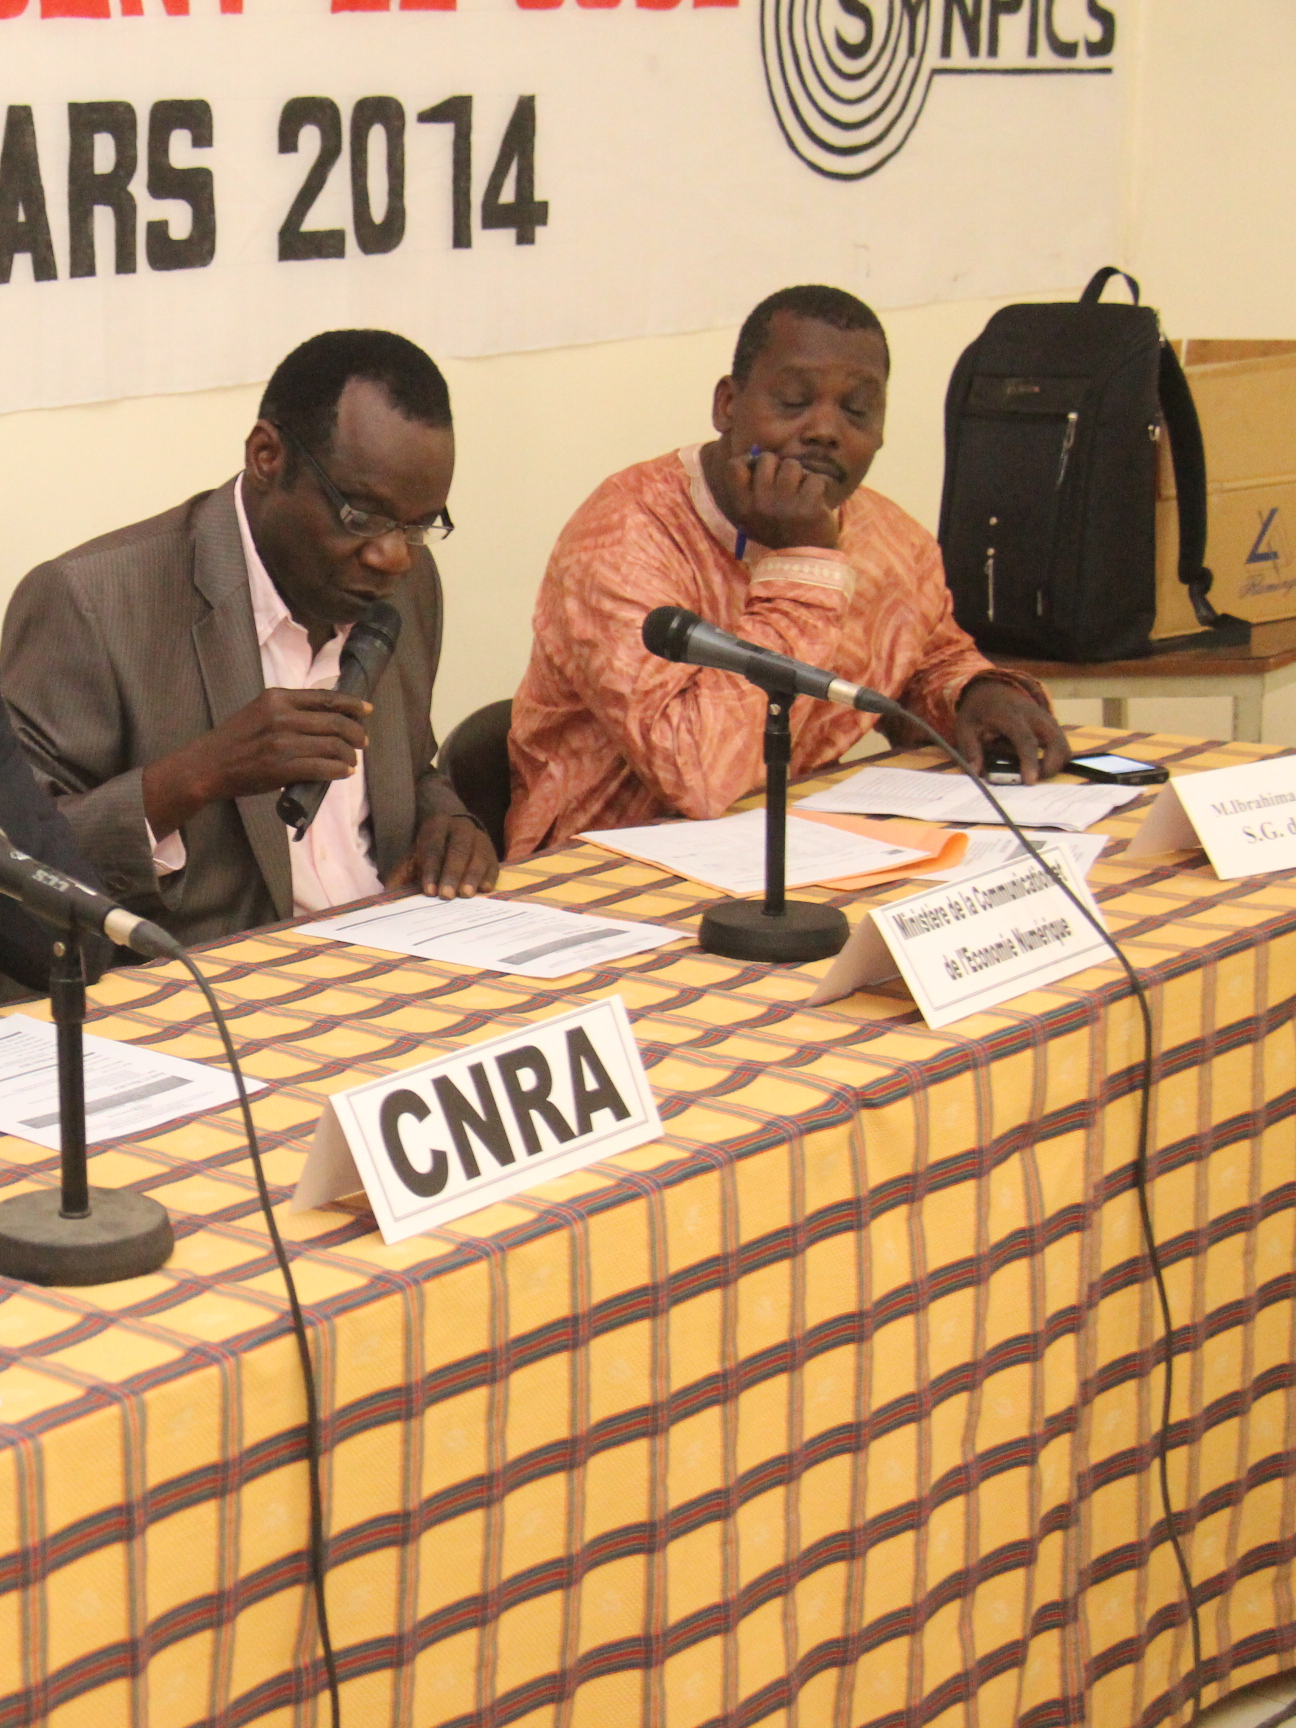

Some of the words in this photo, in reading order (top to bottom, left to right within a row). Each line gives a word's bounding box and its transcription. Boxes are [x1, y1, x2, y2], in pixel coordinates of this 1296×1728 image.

[277, 94, 549, 261] 2014
[1241, 821, 1284, 844] S.G.
[891, 903, 951, 940] Ministère
[946, 895, 966, 921] de
[957, 891, 979, 916] la
[942, 954, 963, 980] de
[1010, 917, 1072, 954] Numérique
[379, 1025, 632, 1198] CNRA
